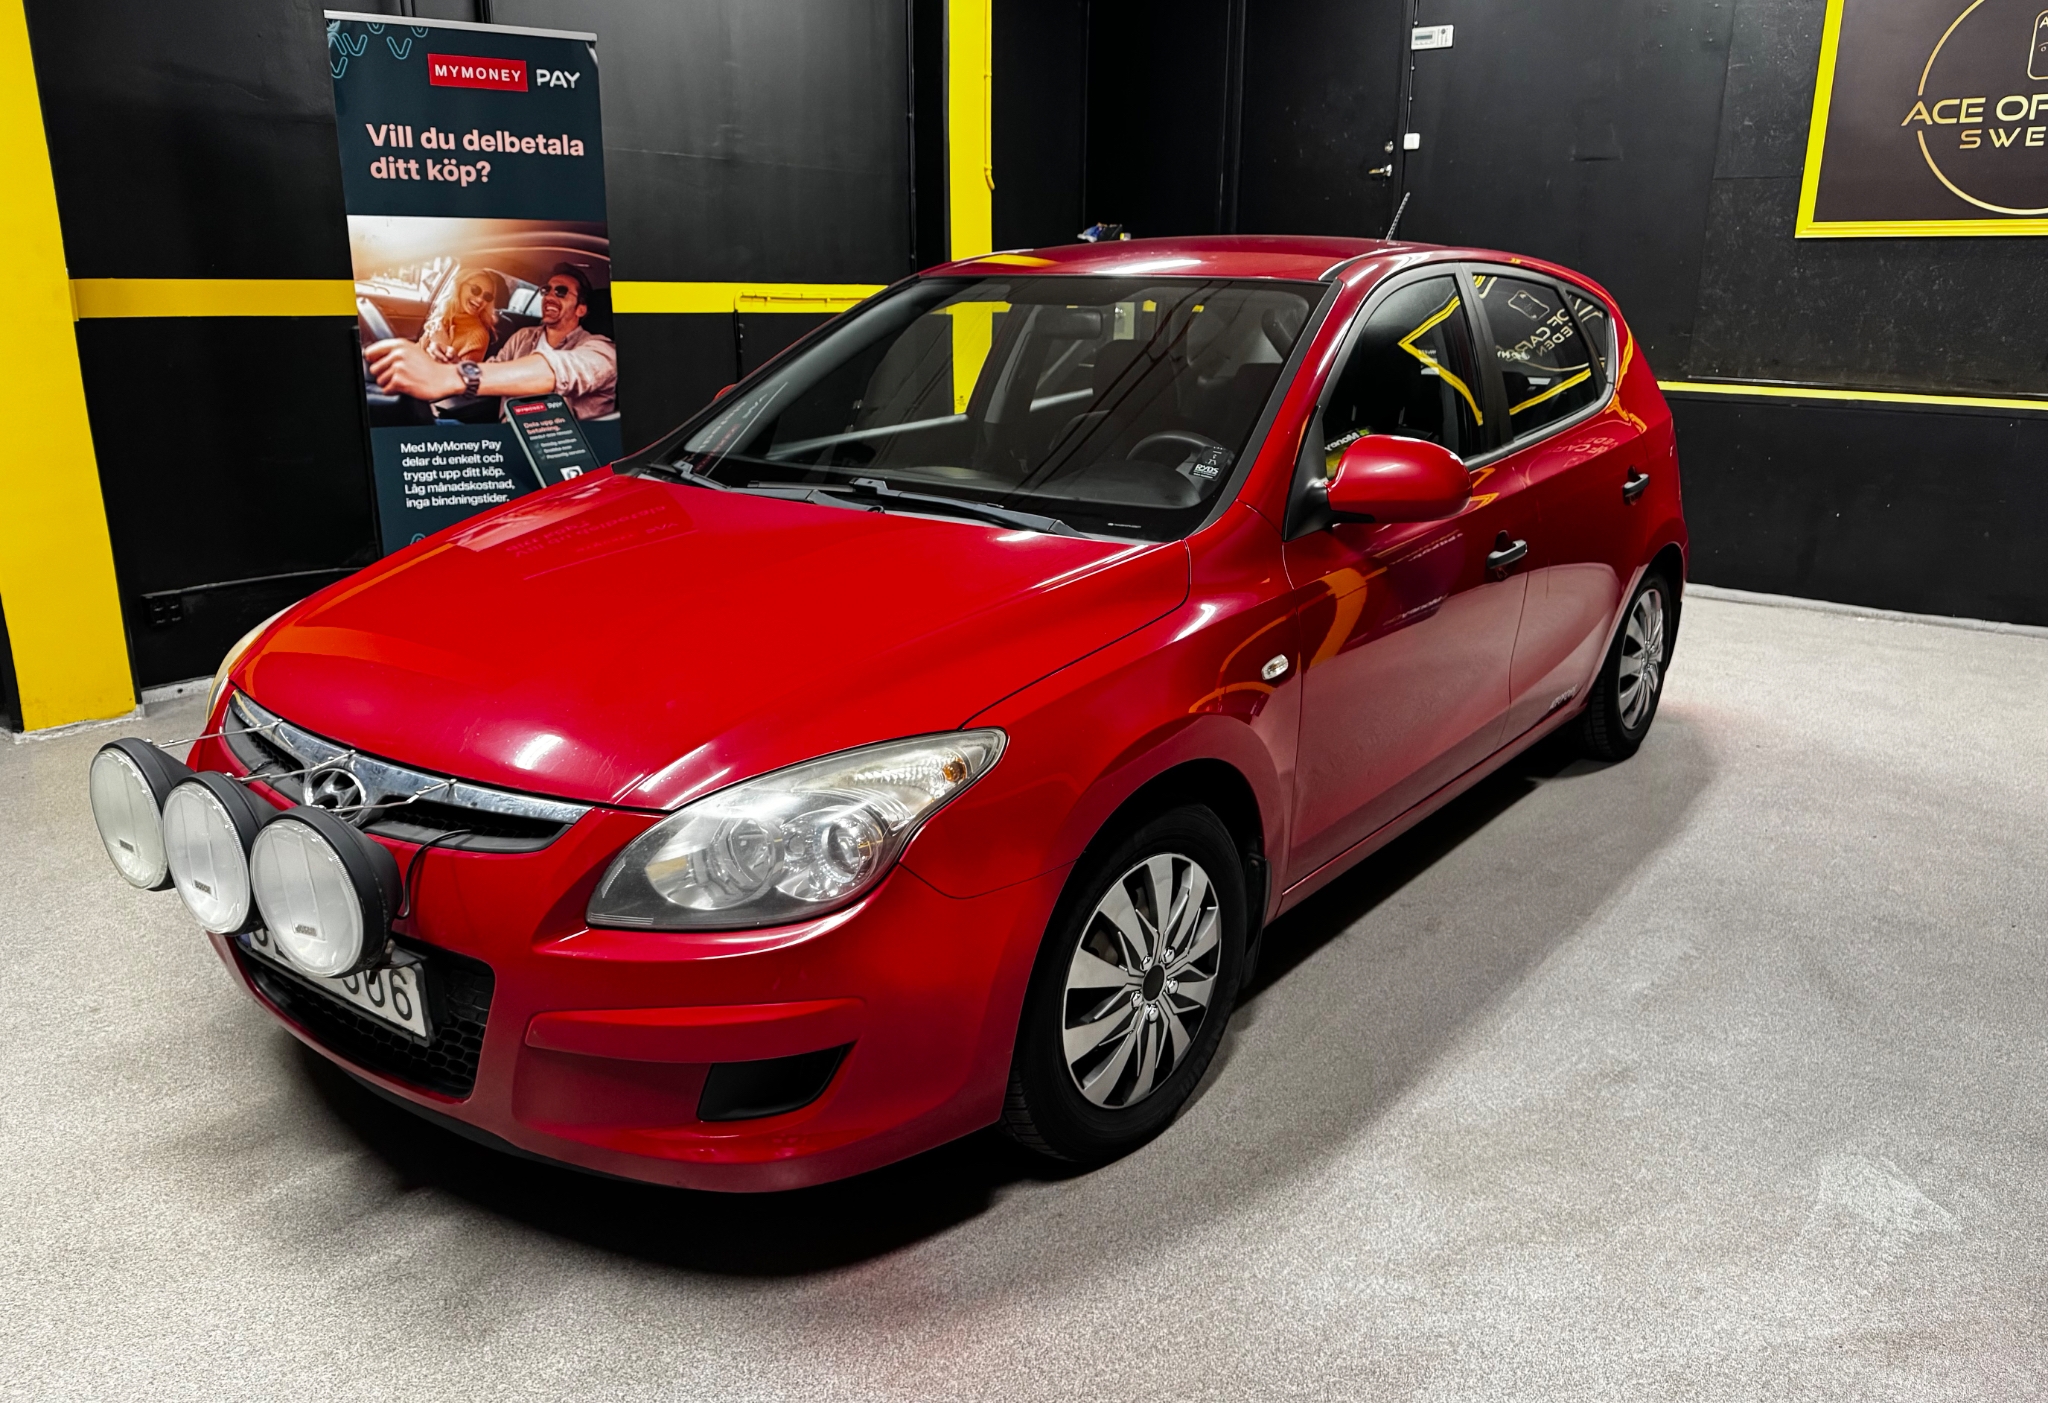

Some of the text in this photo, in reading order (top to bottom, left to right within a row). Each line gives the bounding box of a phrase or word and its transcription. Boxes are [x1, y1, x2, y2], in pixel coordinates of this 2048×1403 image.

[435, 64, 580, 89] MYMONEY PAY
[1901, 97, 1986, 126] ACE
[365, 123, 585, 156] Vill du delbetala
[370, 156, 491, 187] ditt köp?
[400, 439, 502, 454] Med MyMoney Pay
[402, 453, 504, 467] delar du enkelt och
[403, 466, 506, 482] tryggt upp ditt köp.
[404, 479, 515, 496] Låg månadskostnad,
[406, 493, 510, 509] inga bindningstider.
